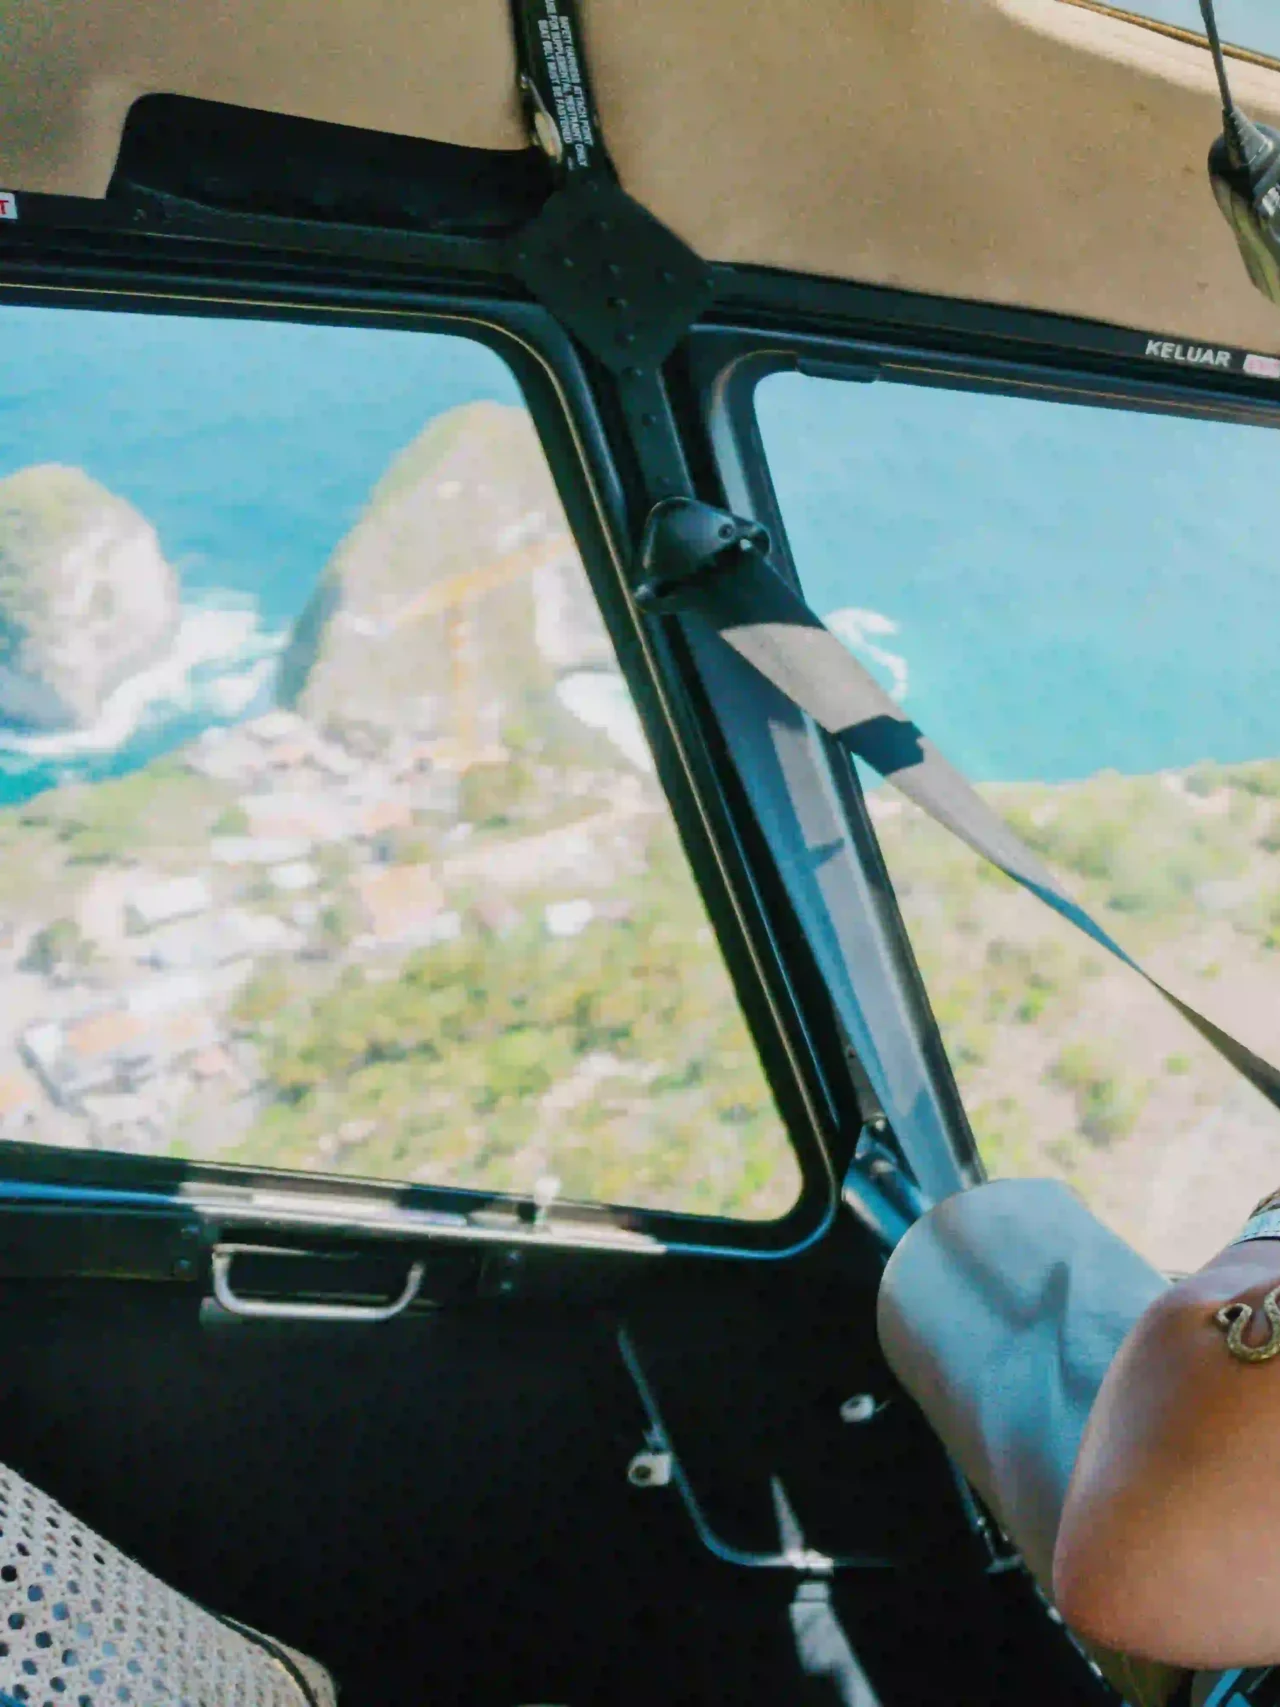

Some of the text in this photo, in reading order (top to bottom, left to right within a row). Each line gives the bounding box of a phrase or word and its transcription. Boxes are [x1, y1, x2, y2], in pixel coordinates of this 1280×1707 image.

[538, 19, 550, 39] SEAT
[548, 15, 559, 30] FOR
[542, 41, 554, 60] BELT
[552, 31, 571, 93] SUPPLEMENTAL
[547, 62, 559, 84] MUST
[559, 16, 594, 147] SAFETY HARNESS ATTACH POINT
[552, 86, 563, 97] BE
[555, 98, 572, 143] FASTENED
[565, 95, 582, 142] RESTRAINT
[575, 143, 589, 167] ONLY
[1145, 339, 1231, 367] KELUAR
